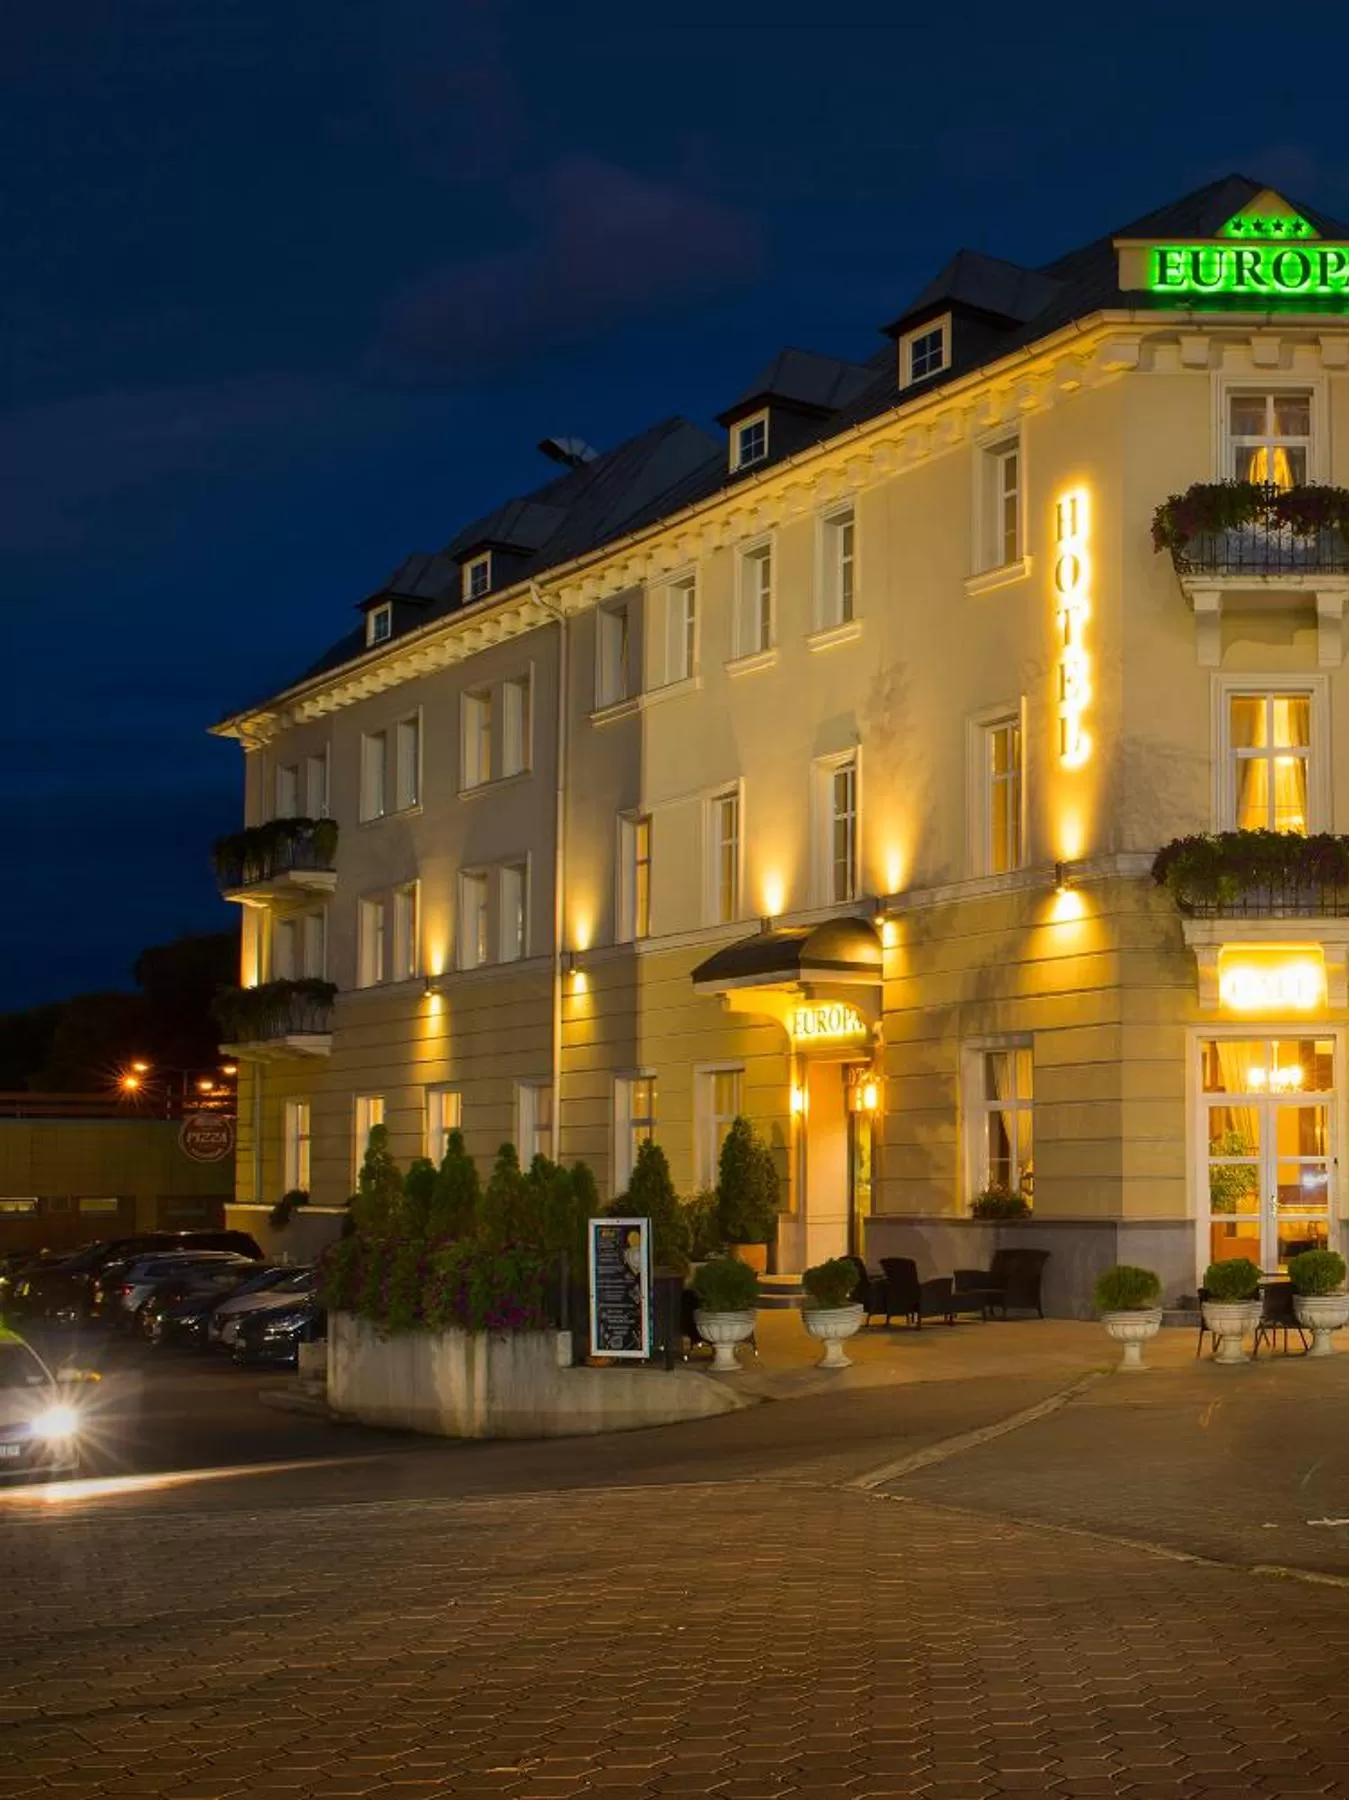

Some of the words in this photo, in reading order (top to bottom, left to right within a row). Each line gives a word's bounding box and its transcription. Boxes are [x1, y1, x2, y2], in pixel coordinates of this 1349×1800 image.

[1053, 494, 1085, 761] HOTEL
[792, 1005, 864, 1036] EUROPA
[186, 1131, 227, 1144] PIZZA
